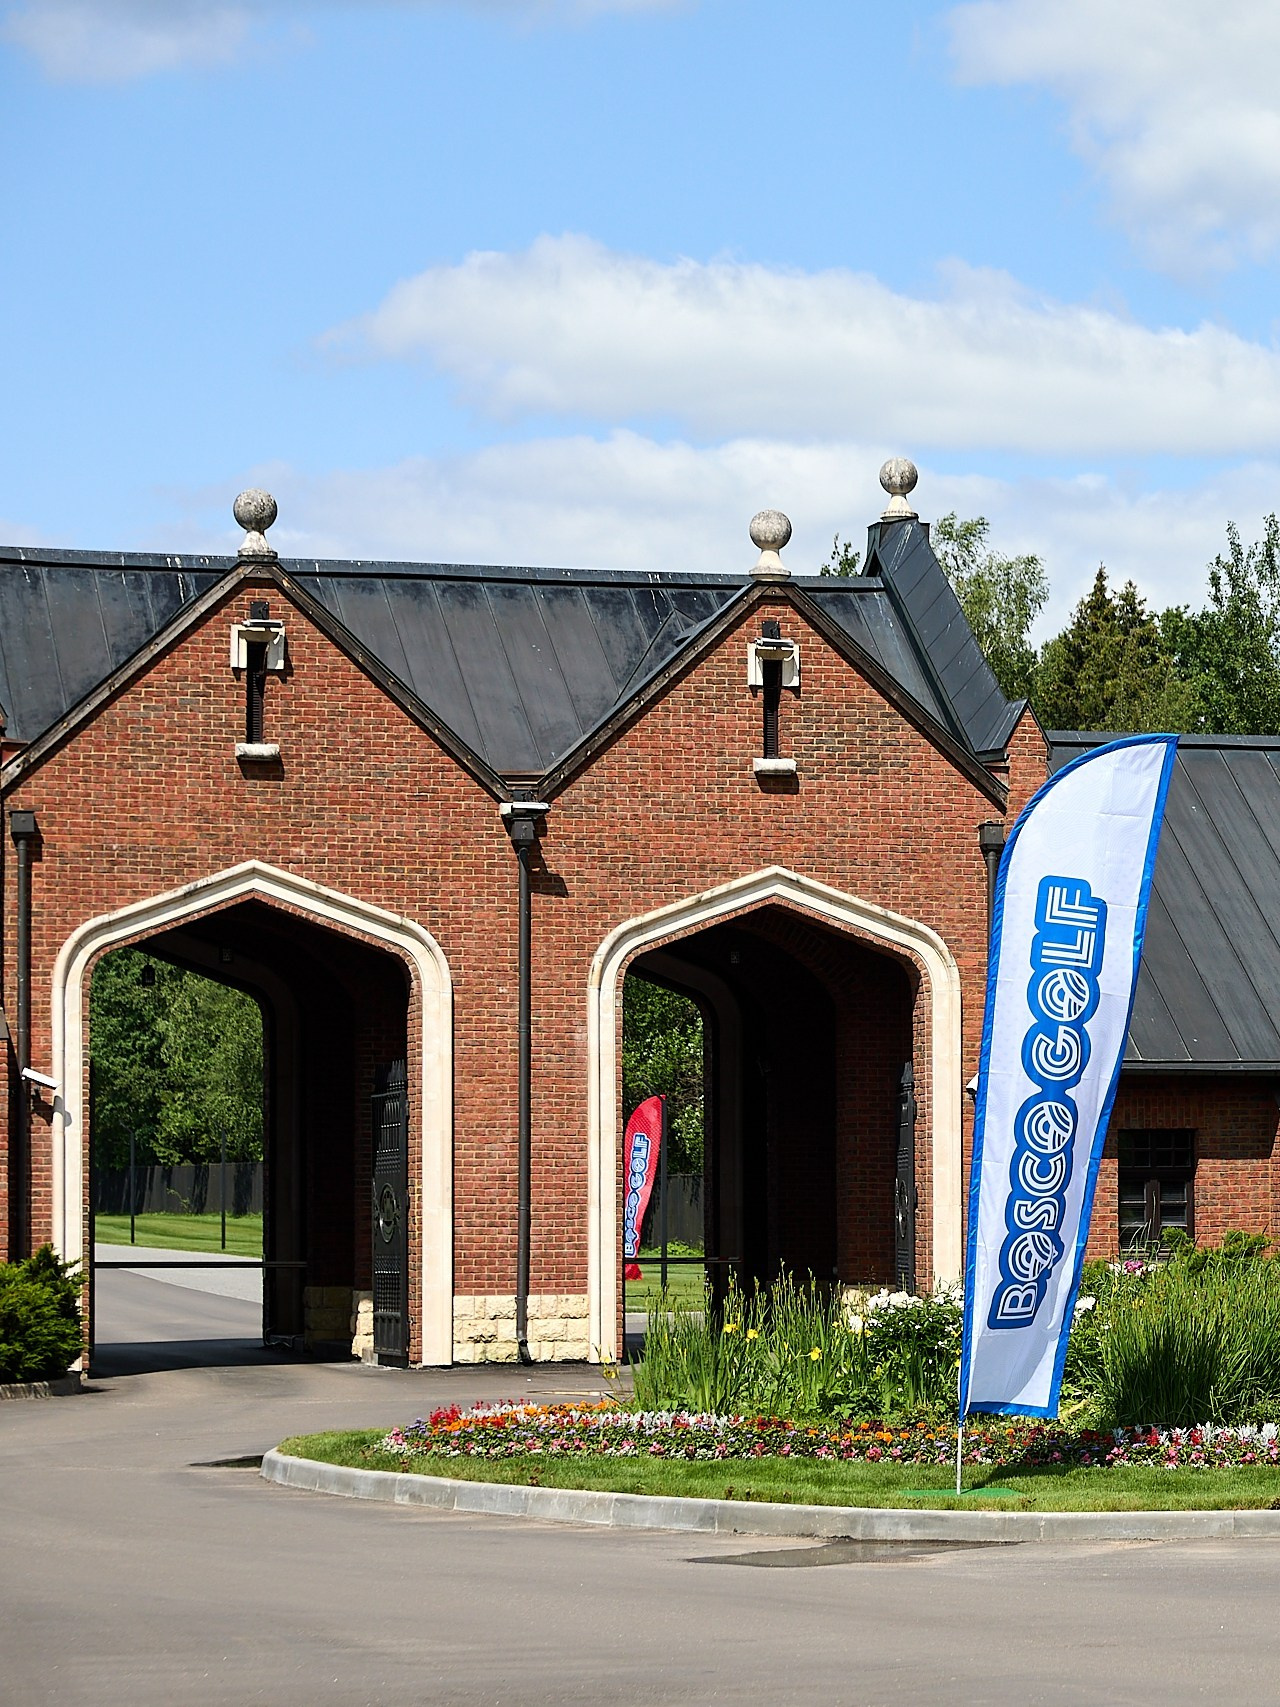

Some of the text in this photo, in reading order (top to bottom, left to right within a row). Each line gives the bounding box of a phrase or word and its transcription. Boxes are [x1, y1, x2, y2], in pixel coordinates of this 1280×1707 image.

[631, 1135, 648, 1189] GOLF
[997, 886, 1101, 1320] BOSCO GOLF
